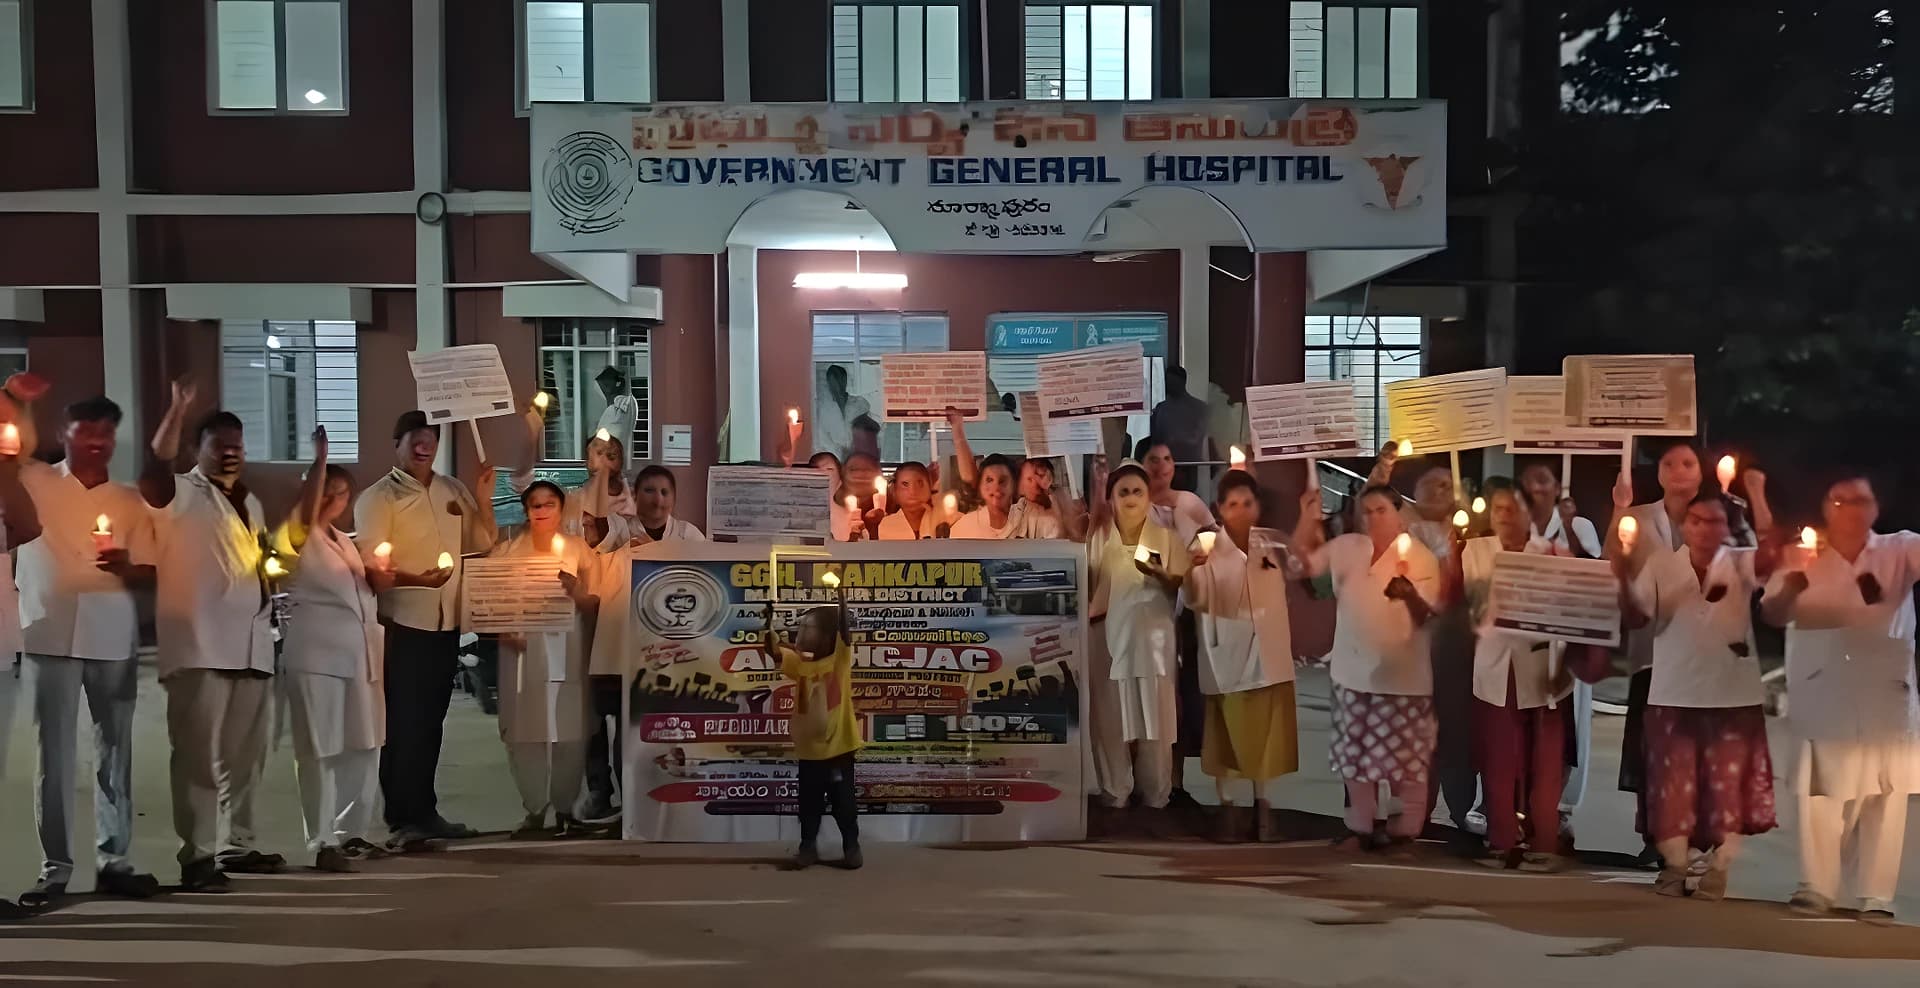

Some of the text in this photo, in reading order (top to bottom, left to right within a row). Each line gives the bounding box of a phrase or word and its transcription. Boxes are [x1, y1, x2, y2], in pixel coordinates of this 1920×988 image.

[637, 154, 1345, 185] GOVERNMENT GENERAL HOSPITAL
